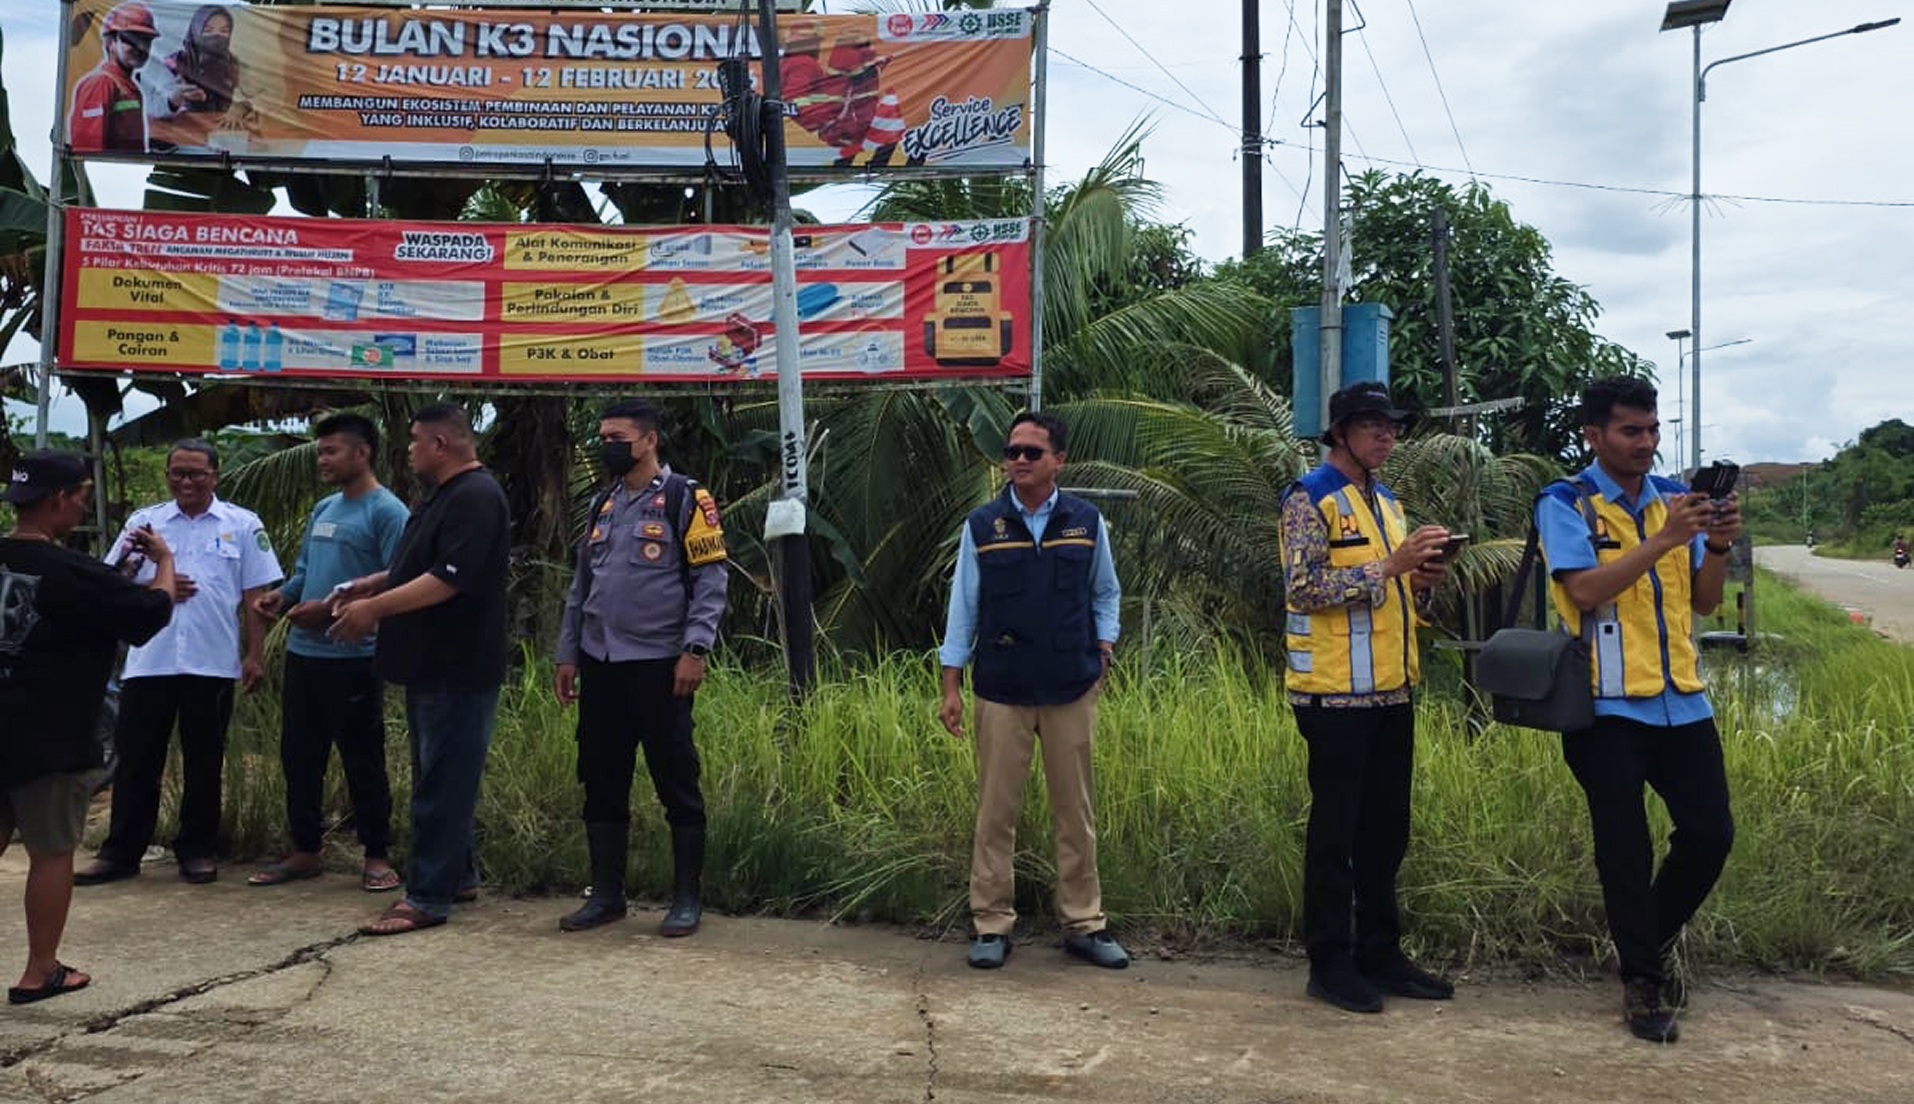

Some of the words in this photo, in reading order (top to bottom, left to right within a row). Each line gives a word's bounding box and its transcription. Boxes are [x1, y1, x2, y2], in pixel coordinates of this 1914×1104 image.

[310, 17, 465, 56] BULAN
[477, 21, 536, 57] K3
[547, 23, 784, 59] NASIONA
[337, 62, 367, 83] 12
[375, 64, 492, 86] JANUARI
[523, 67, 551, 87] 12
[560, 67, 685, 89] FEBRUARI
[301, 96, 397, 110] MEMBANGUN
[402, 99, 480, 112] EKOSISTEM
[486, 101, 572, 114] PEMBINAAN
[577, 103, 607, 114] DAN
[612, 103, 696, 115] PELAYANAN
[931, 97, 990, 120] Service
[361, 113, 401, 126] YANG
[407, 114, 475, 128] INKLUSIF,
[480, 116, 578, 129] KOLABORATIF
[582, 118, 613, 130] DAN
[904, 105, 1022, 155] EXCELLENCE
[82, 221, 116, 238] TAS
[123, 223, 188, 241] SIAGA
[196, 227, 298, 245] BENCANA
[404, 233, 485, 248] WASPADA
[516, 237, 545, 249] Alat
[550, 238, 636, 251] Komunikasi
[396, 246, 491, 261] SEKARANG!
[523, 252, 533, 262] &
[538, 251, 628, 265] Penerangan
[82, 257, 89, 267] 5
[93, 257, 121, 267] Pilar
[230, 263, 245, 273] 72
[249, 263, 272, 276] jam
[113, 276, 182, 290] Dokumen
[130, 291, 164, 303] Vital
[535, 289, 594, 301] Pakaian
[601, 290, 611, 300] &
[507, 302, 607, 316] Perlindungan
[612, 303, 638, 314] Diri
[108, 328, 164, 343] Pangan
[169, 331, 179, 342] &
[118, 343, 167, 356] Cairan
[527, 348, 556, 360] P3K
[561, 349, 572, 360] &
[577, 348, 614, 360] Obat
